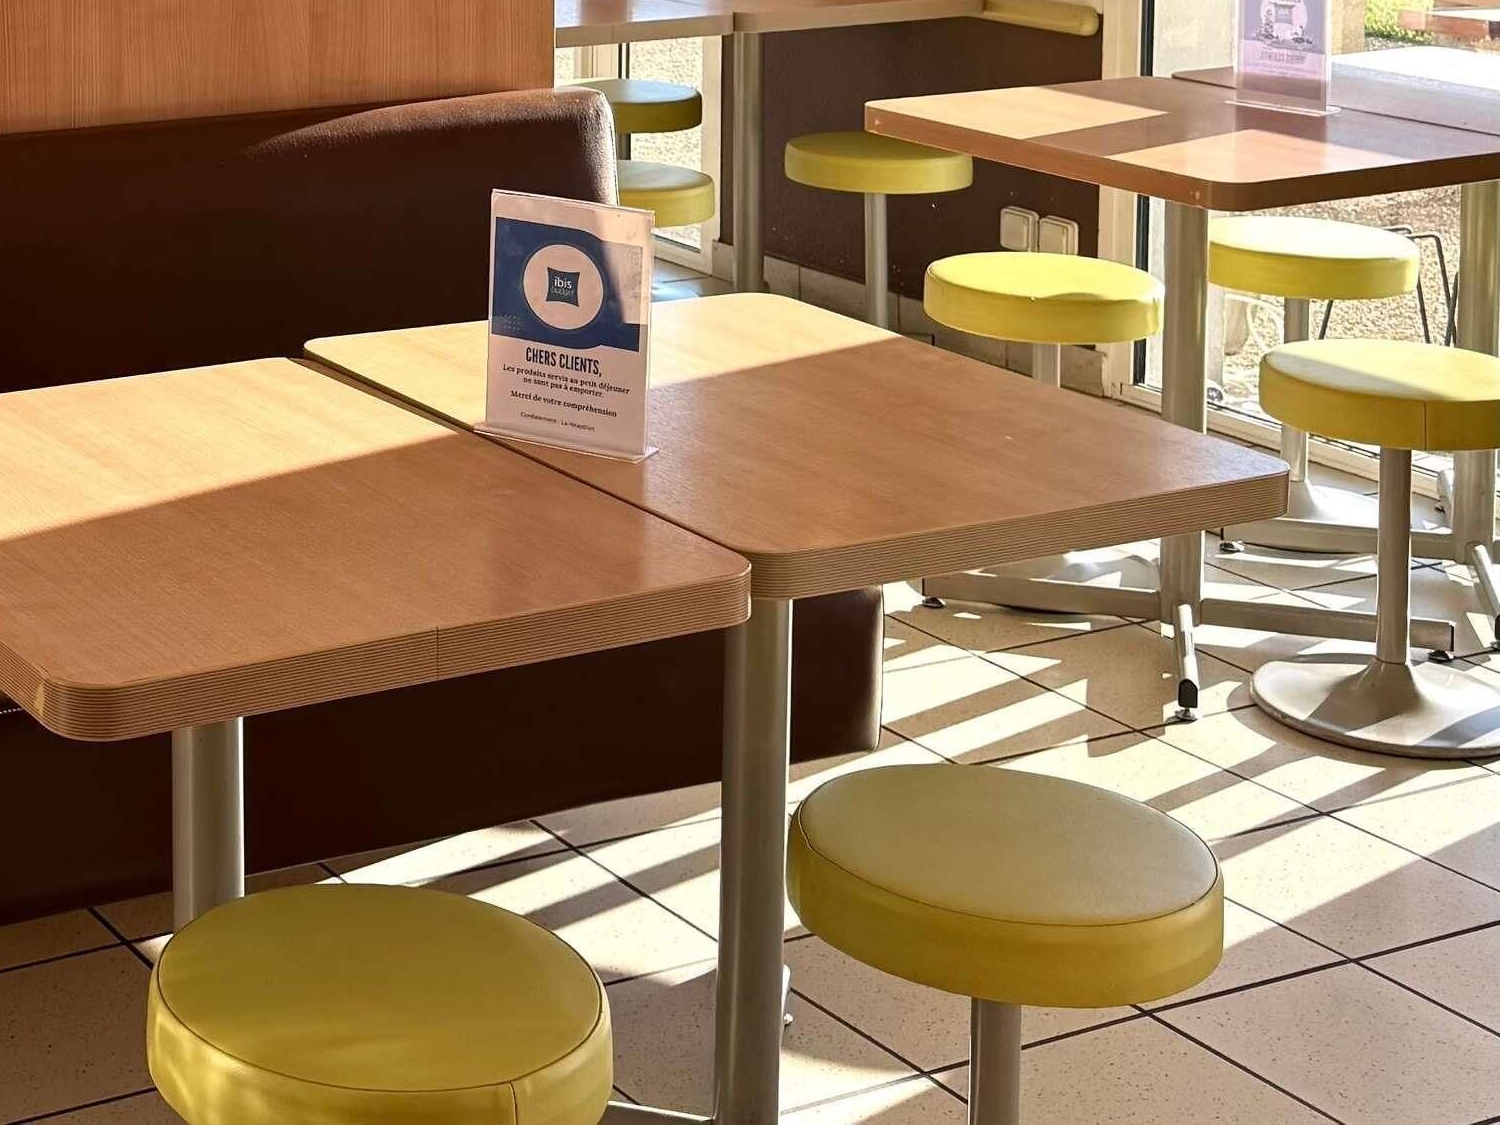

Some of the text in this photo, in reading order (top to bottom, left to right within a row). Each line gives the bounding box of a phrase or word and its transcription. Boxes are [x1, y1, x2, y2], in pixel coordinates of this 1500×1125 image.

[554, 275, 573, 289] ibis
[526, 347, 601, 377] CHERS CLIENTS,
[503, 364, 515, 372] Les
[516, 367, 546, 377] produits
[547, 373, 568, 382] servis
[580, 379, 597, 388] petit
[599, 382, 630, 394] déjeuner
[534, 378, 549, 386] sont
[510, 390, 532, 400] Merci
[533, 394, 542, 402] de
[543, 397, 562, 406] votre
